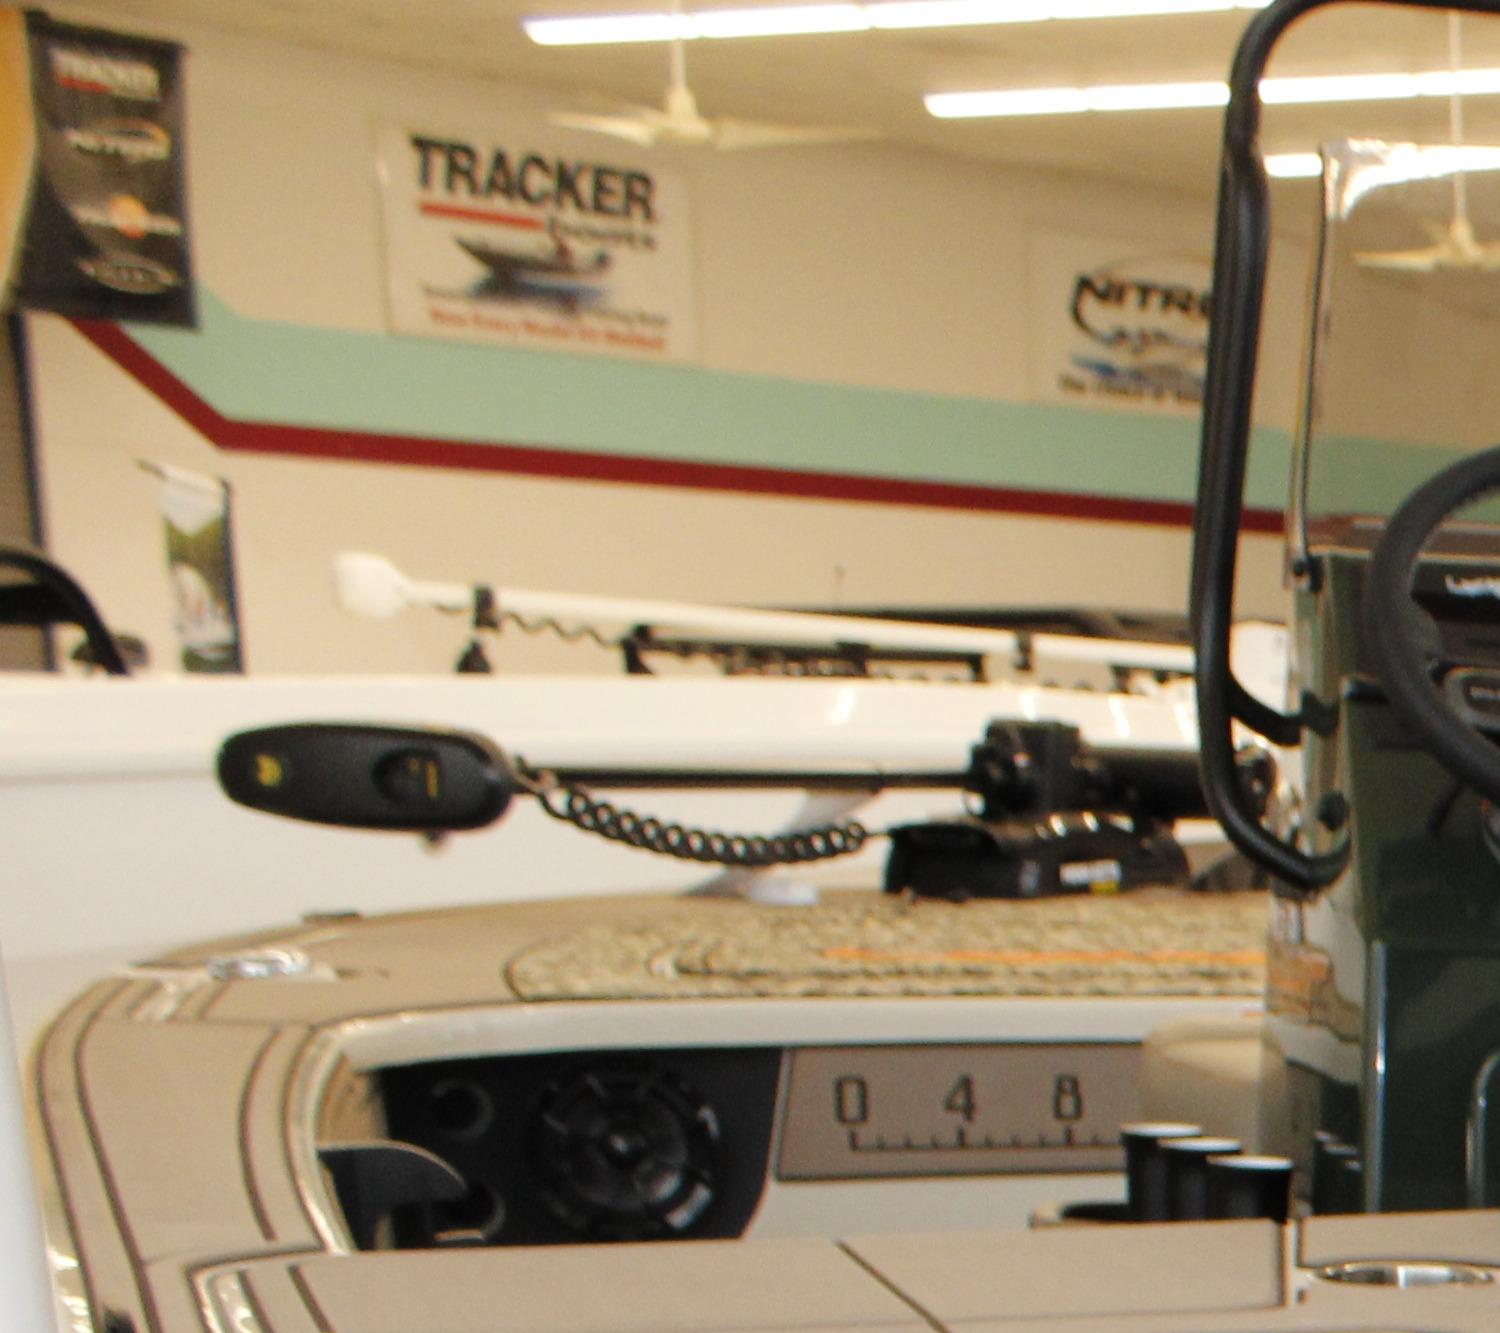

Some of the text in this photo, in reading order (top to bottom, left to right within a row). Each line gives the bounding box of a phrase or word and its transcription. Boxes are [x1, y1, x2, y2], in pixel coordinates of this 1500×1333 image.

[409, 133, 659, 222] TRACKER
[835, 1073, 1084, 1126] 0 4 8
